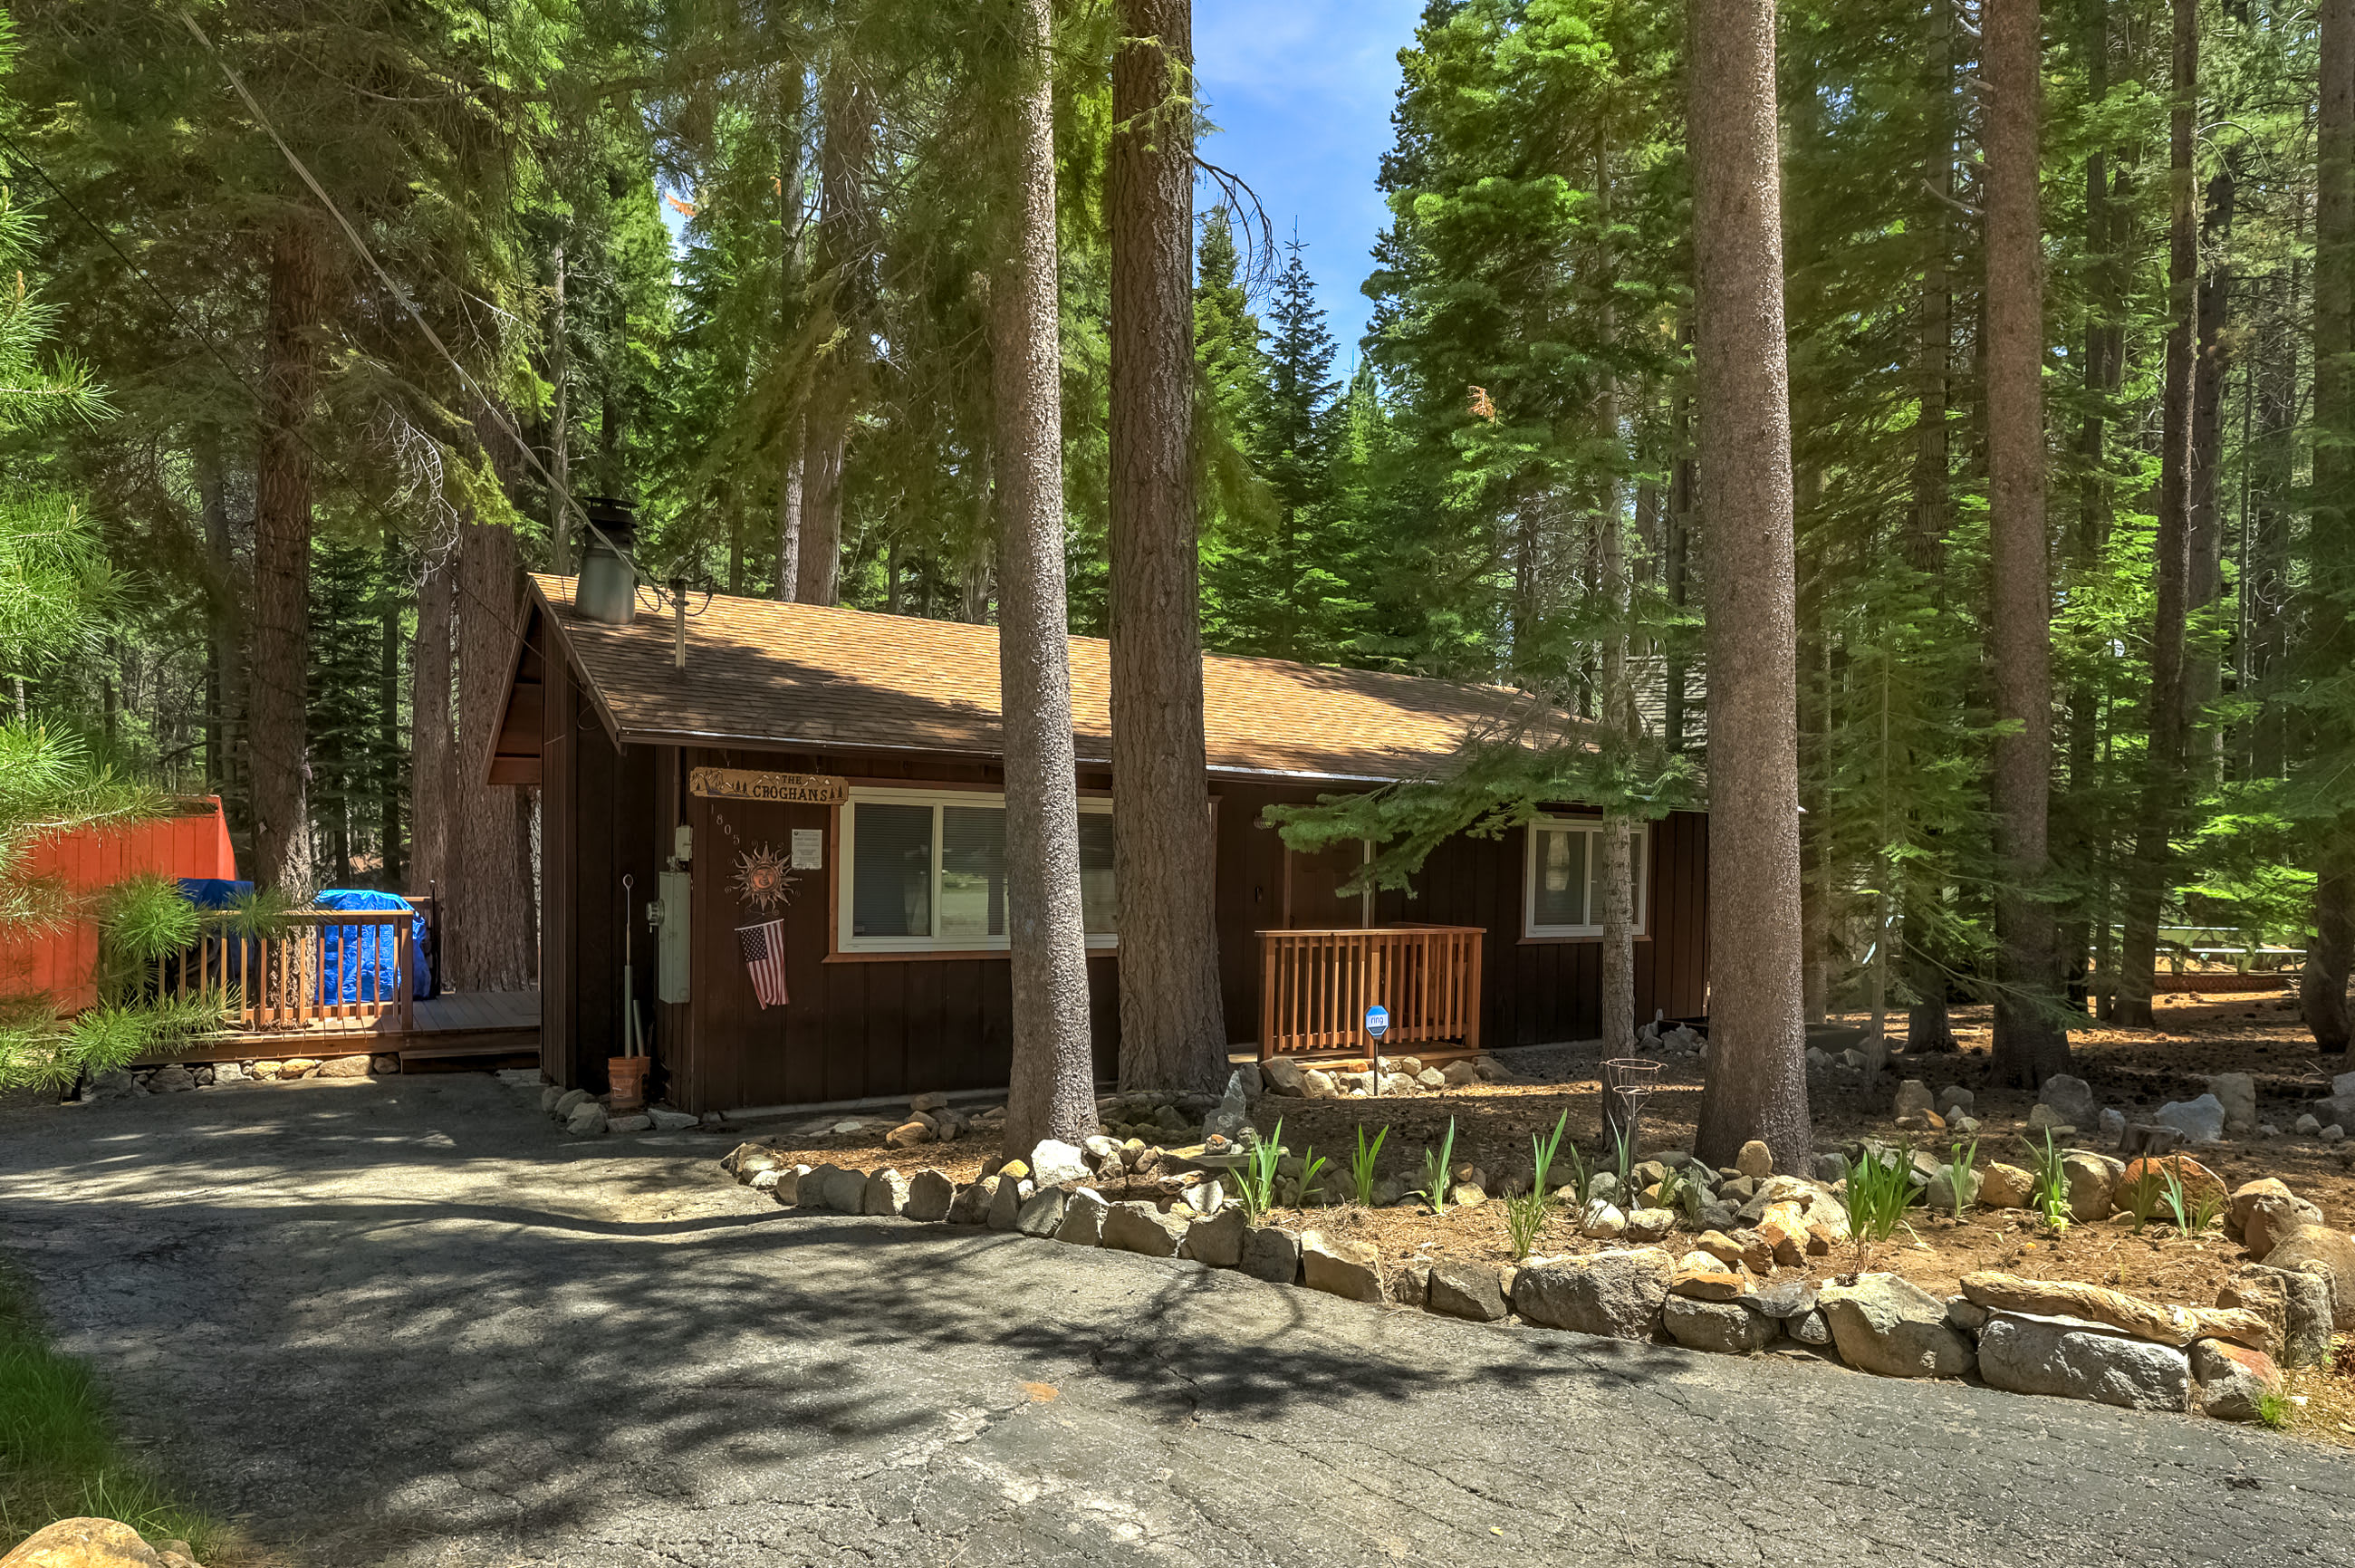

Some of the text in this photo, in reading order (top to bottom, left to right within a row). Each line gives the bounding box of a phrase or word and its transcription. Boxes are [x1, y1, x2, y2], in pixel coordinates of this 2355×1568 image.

[782, 774, 802, 784] THE
[753, 785, 828, 802] CROGHANS
[1370, 1016, 1384, 1025] ring
